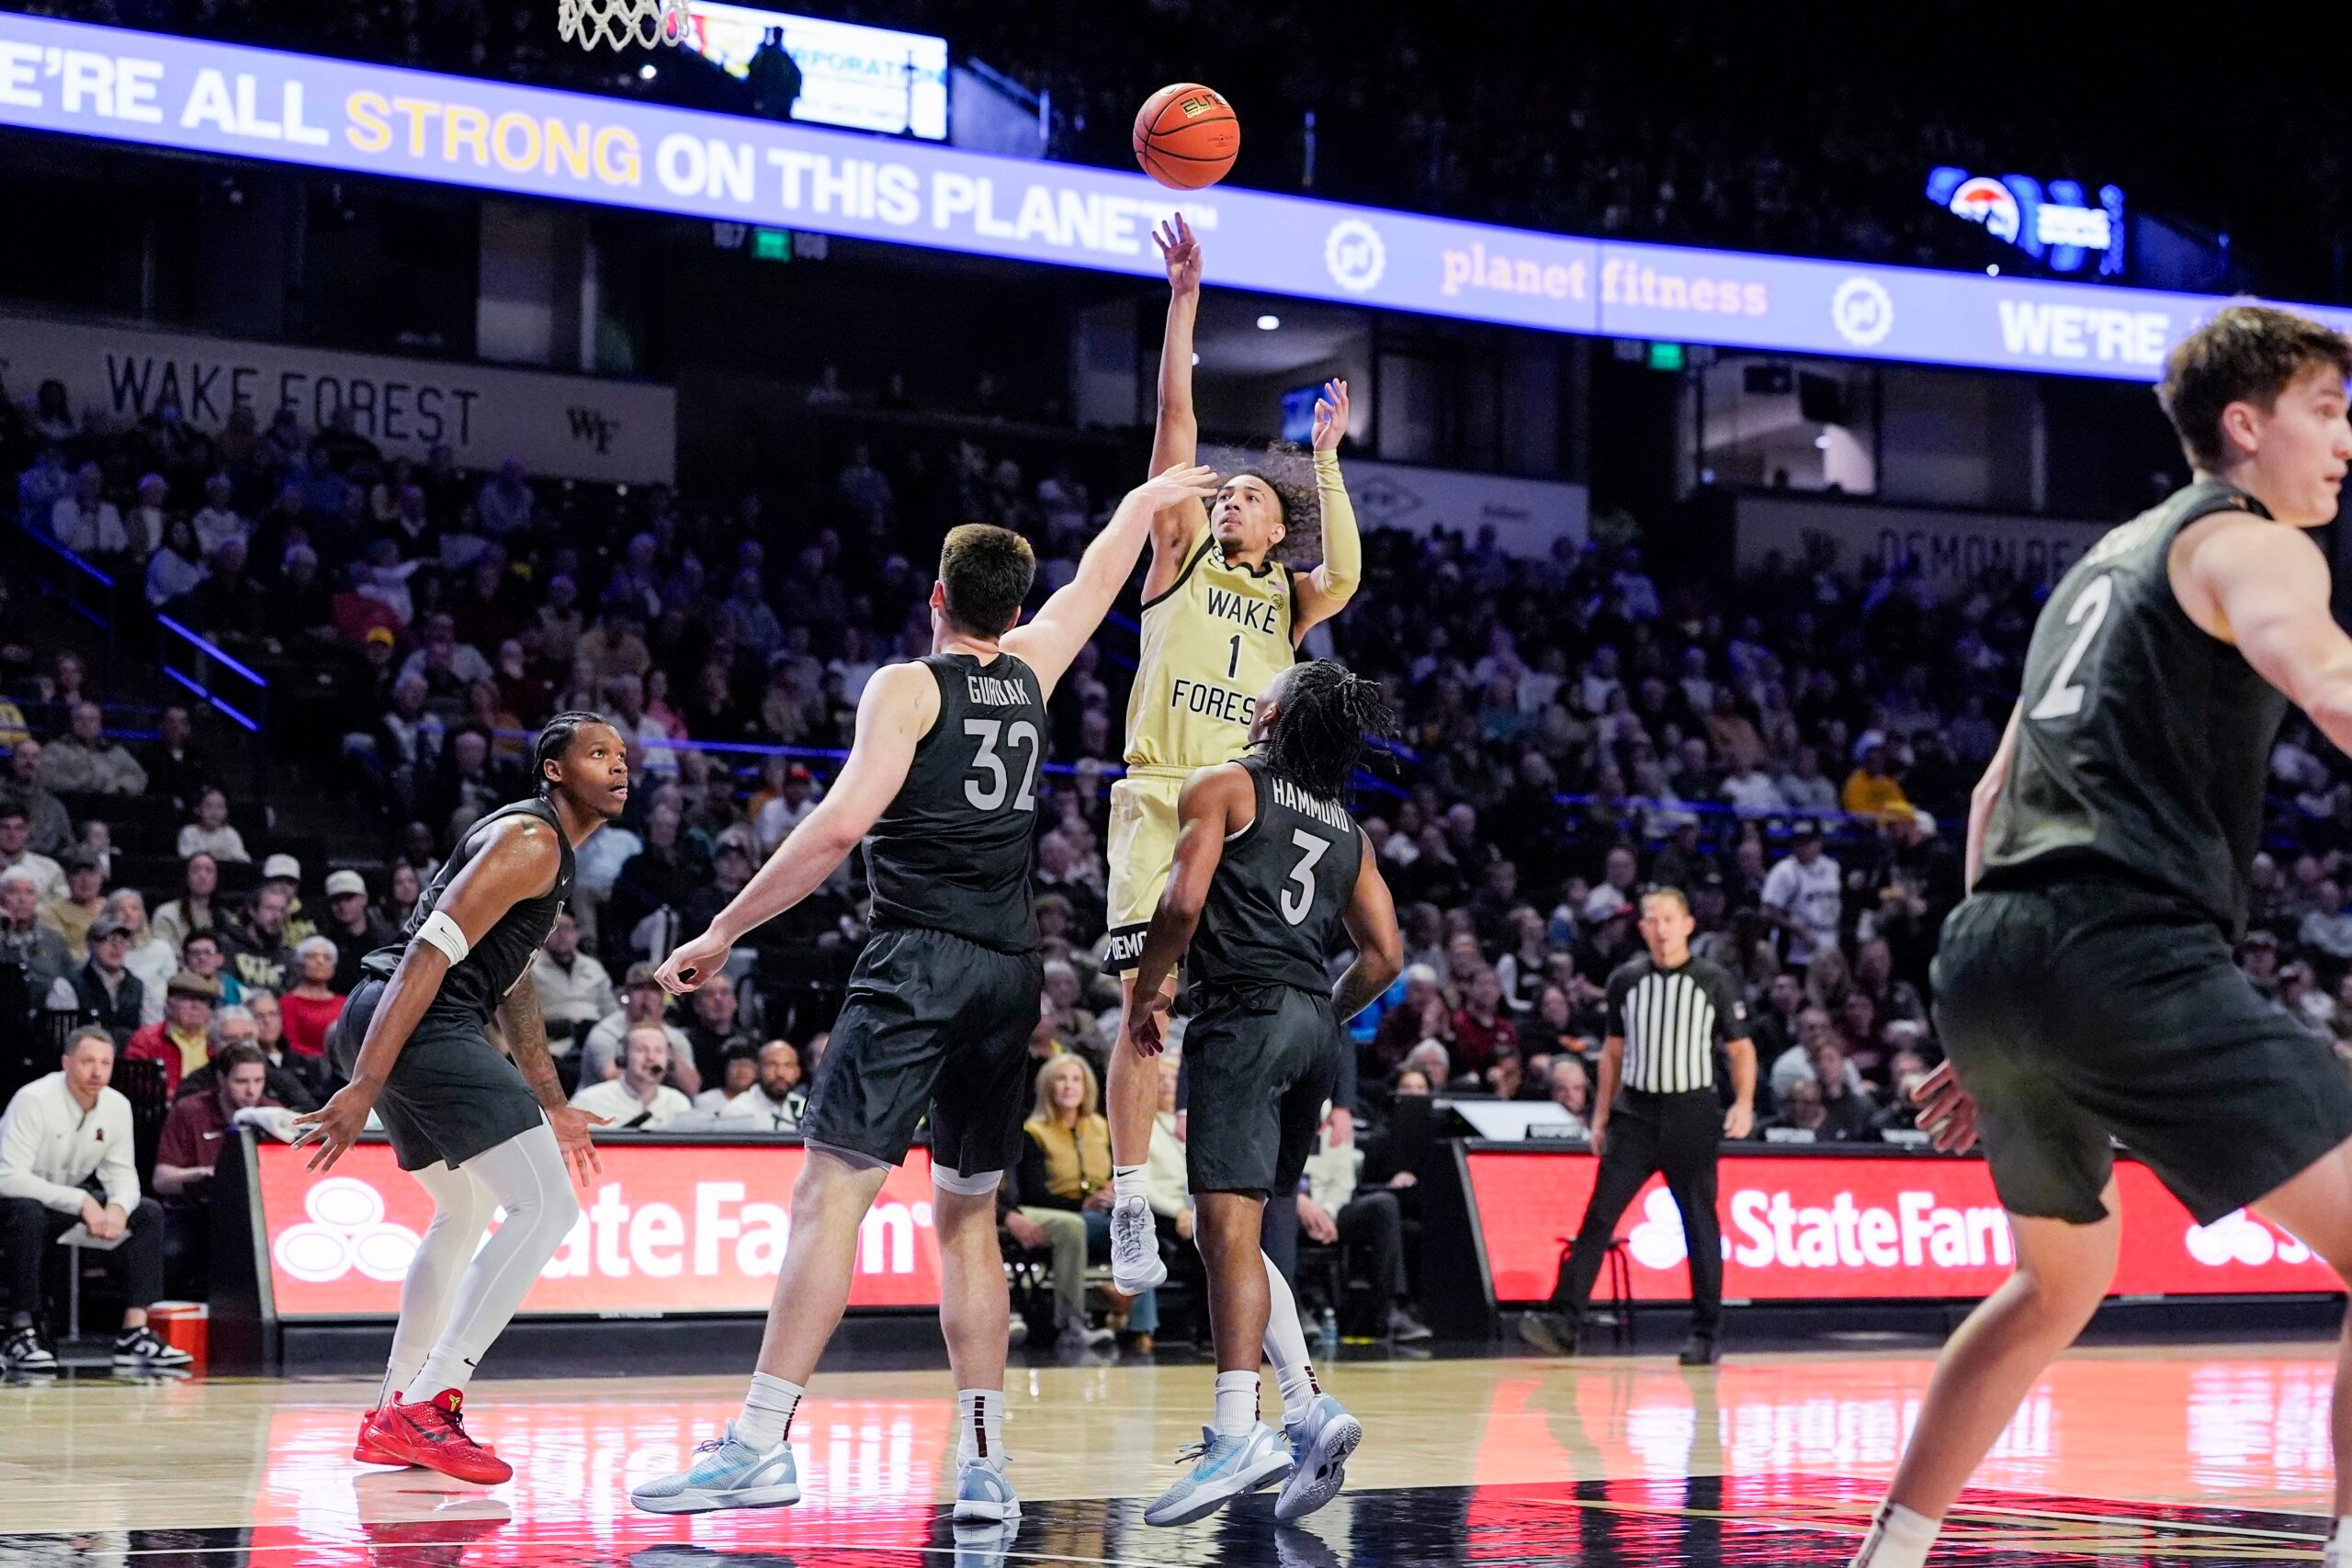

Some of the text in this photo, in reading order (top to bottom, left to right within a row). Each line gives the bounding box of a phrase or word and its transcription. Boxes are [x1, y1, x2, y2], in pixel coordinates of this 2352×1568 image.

[0, 40, 164, 125] E'RE
[180, 68, 330, 147] ALL
[345, 90, 640, 188] STRONG
[656, 132, 755, 203] ON
[767, 147, 920, 226] THIS
[1442, 242, 1769, 317] planet fitness
[107, 352, 480, 449] WAKE FOREST
[1208, 586, 1276, 636] WAKE
[2029, 574, 2113, 721] 2
[1227, 634, 1242, 679] 1
[1170, 678, 1257, 727] FORES
[964, 718, 1039, 812] 32
[1280, 828, 1331, 926] 3
[1112, 931, 1148, 961] DEMO
